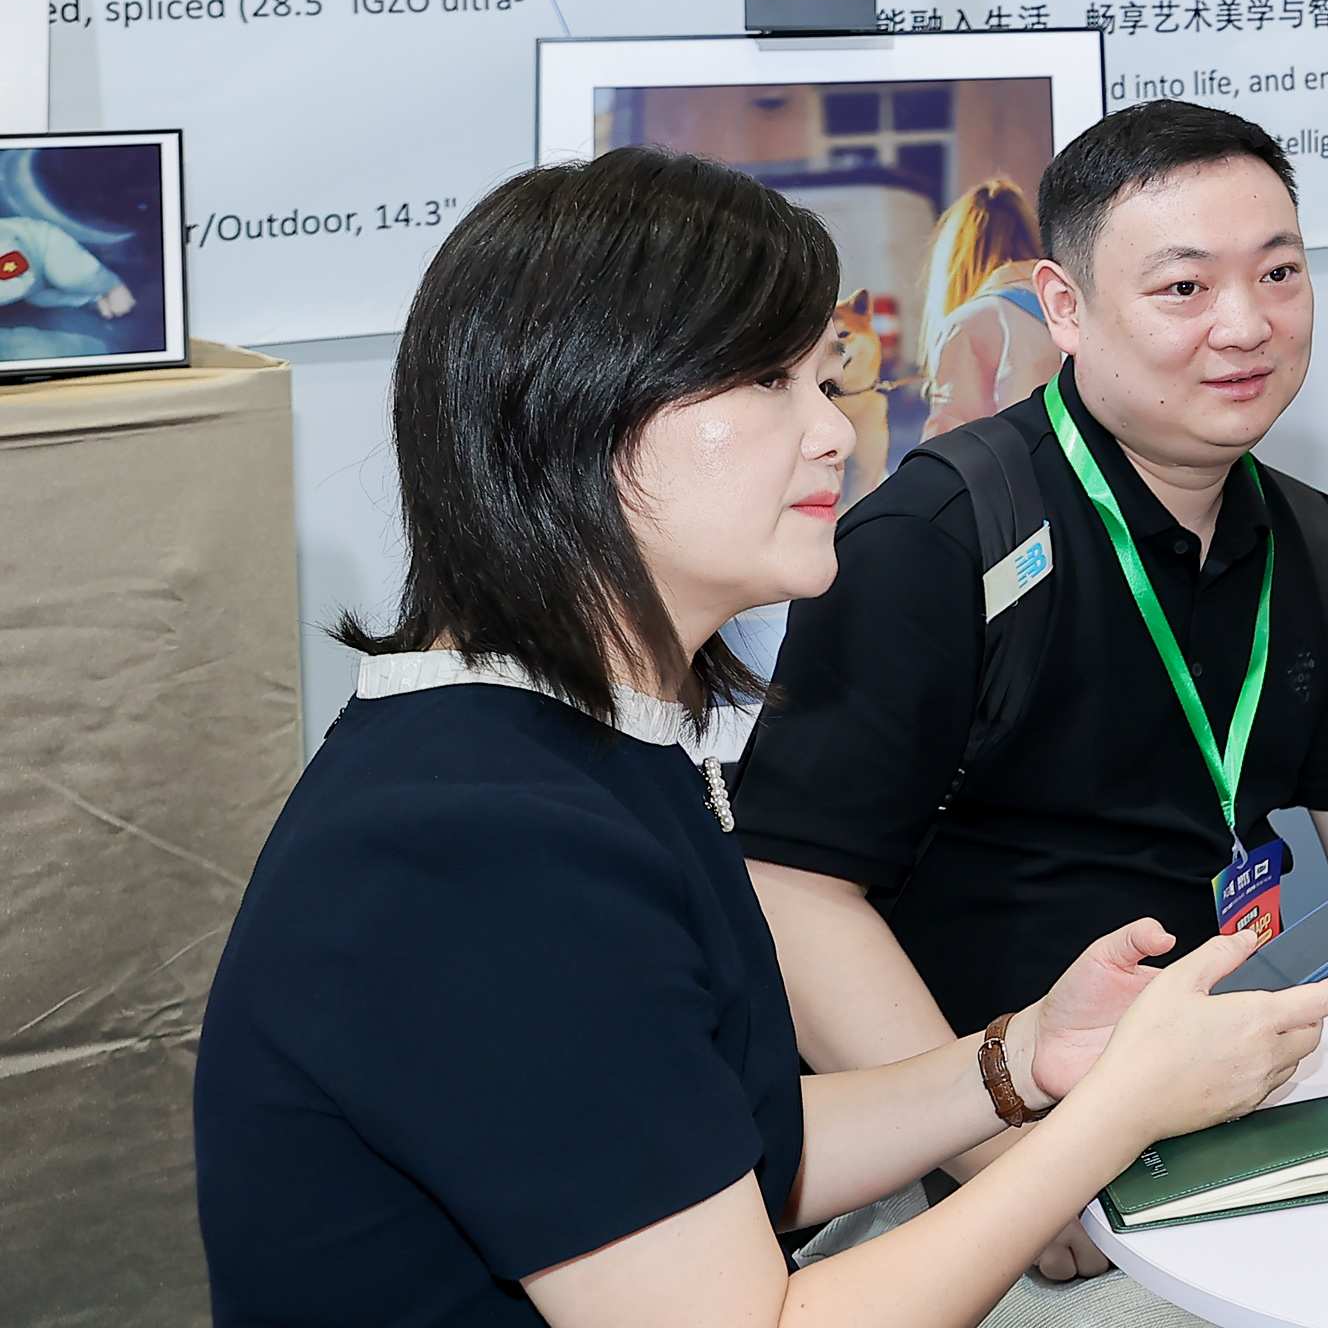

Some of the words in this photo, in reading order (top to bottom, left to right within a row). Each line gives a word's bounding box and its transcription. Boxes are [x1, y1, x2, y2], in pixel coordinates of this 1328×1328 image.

[1135, 72, 1185, 98] into
[1193, 70, 1240, 97] life,
[1249, 65, 1296, 93] and
